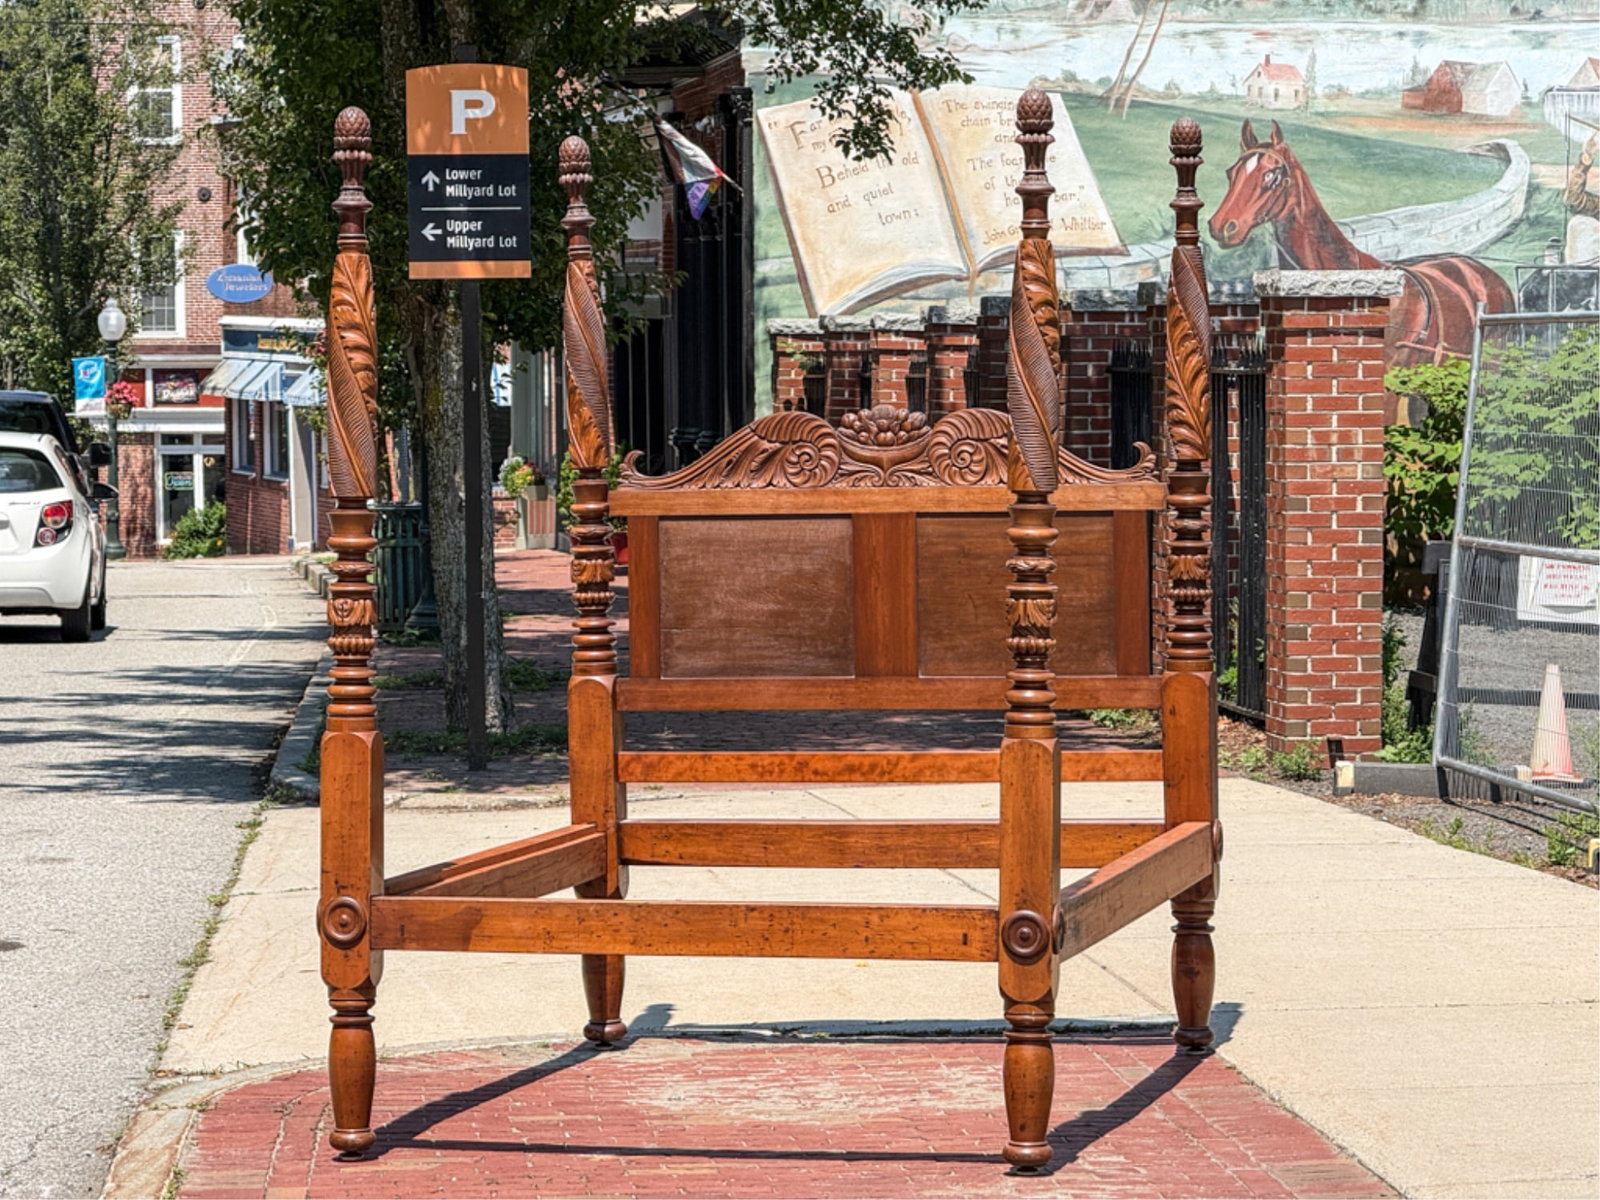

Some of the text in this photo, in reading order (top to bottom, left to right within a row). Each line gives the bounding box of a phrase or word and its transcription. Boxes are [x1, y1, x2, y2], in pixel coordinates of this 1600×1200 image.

[449, 89, 496, 135] P
[942, 97, 1017, 114] The swingin
[816, 161, 870, 190] Beheld
[901, 151, 920, 167] old
[966, 157, 993, 172] The
[445, 168, 483, 181] Lower
[446, 184, 517, 200] Millyard Lot
[827, 182, 895, 214] and quiet
[446, 218, 484, 233] Upper
[446, 235, 518, 250] Millyard Lot
[983, 227, 1008, 246] John
